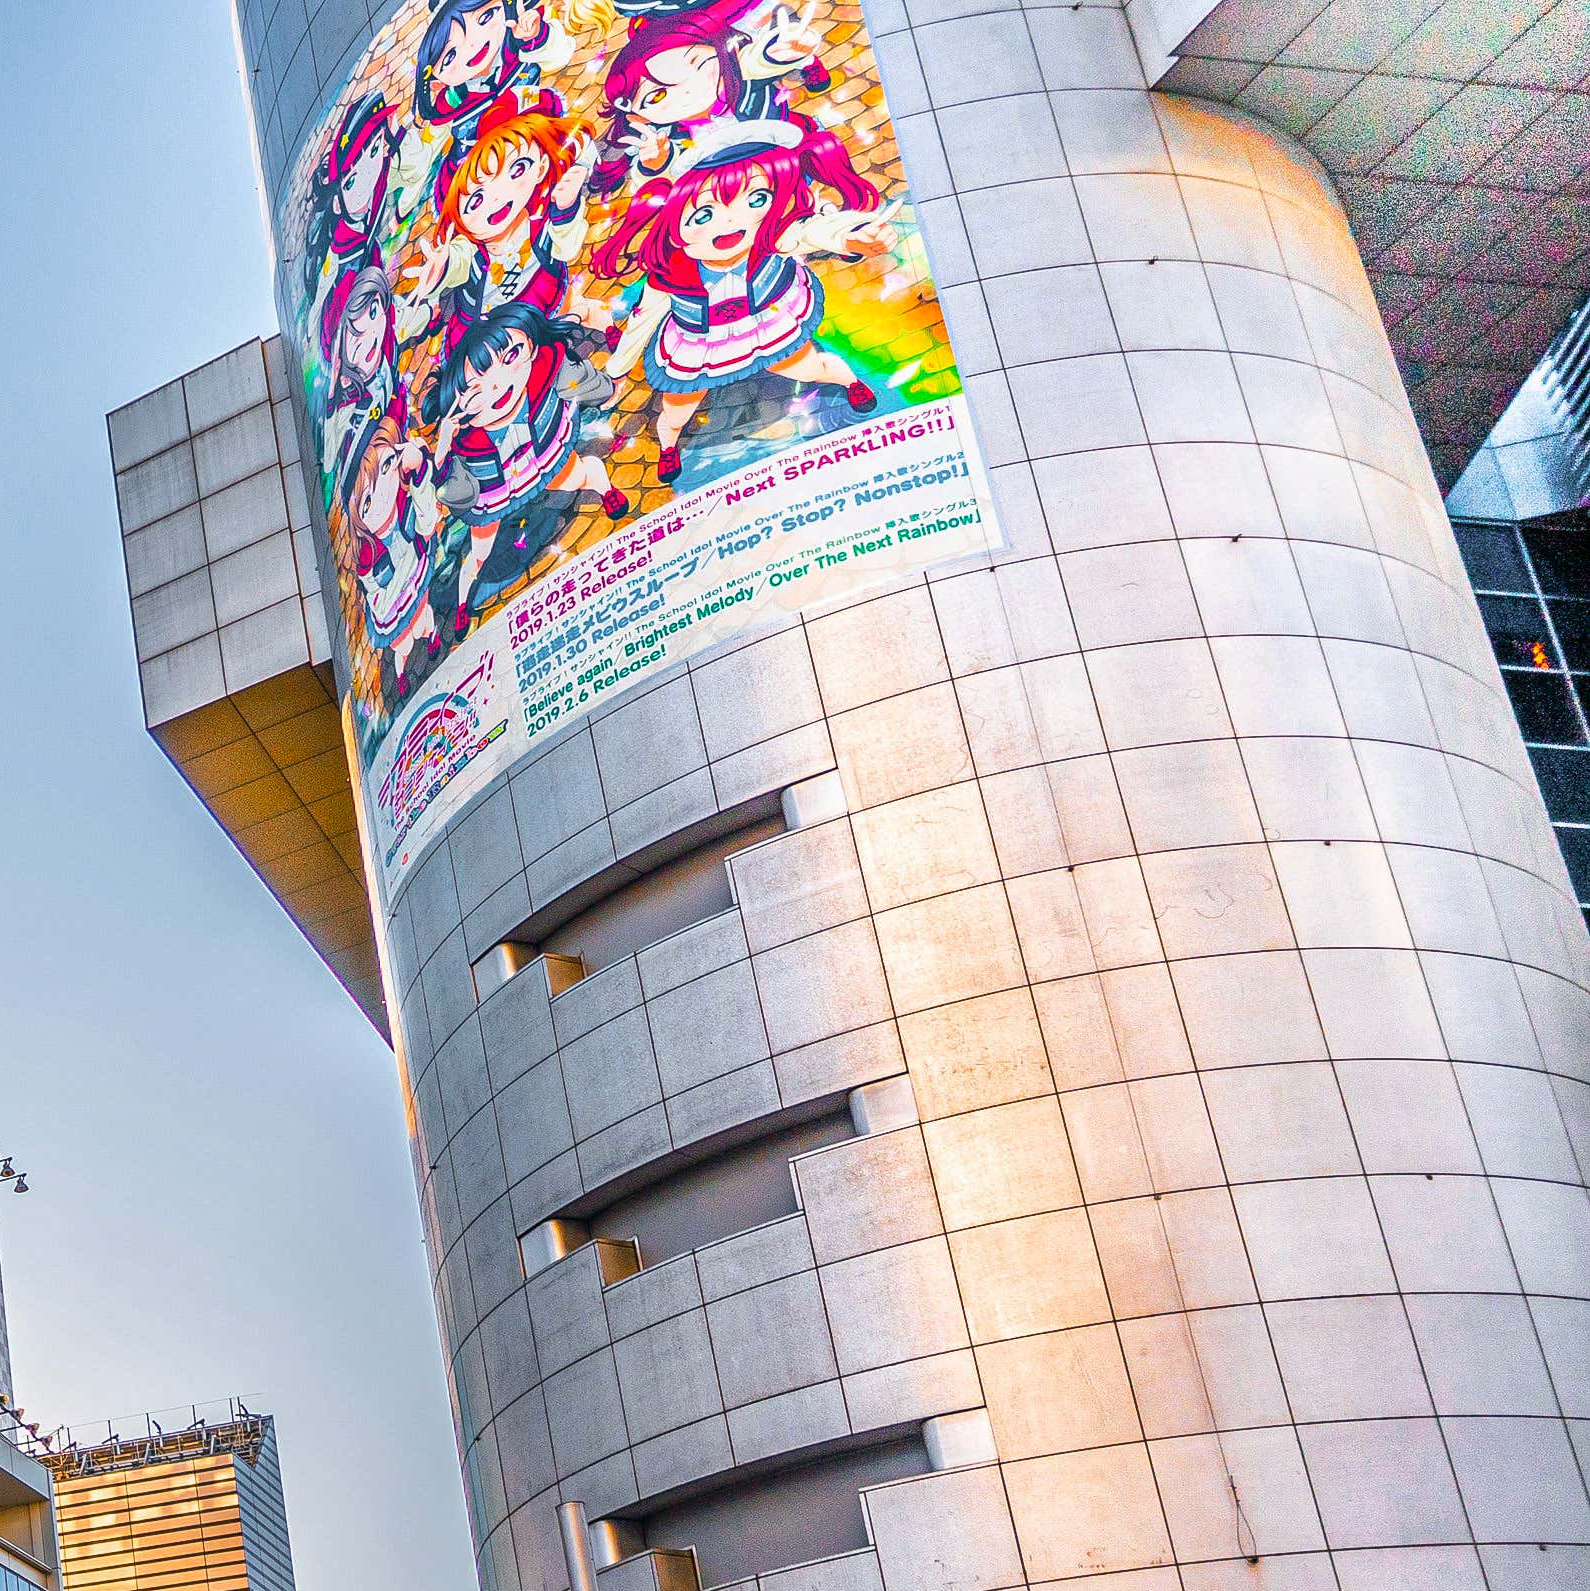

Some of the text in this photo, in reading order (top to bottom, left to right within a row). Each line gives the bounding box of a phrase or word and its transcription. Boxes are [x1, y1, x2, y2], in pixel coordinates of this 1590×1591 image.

[617, 433, 857, 545] The School Idol Movie Over The Rainbow
[625, 479, 869, 588] The School Idol Movie Over The Rainbow
[781, 498, 847, 533] Stop?
[510, 550, 653, 650] 2019.1.23 Release!
[635, 525, 881, 634] The School Idol Movie Over The Rainbow
[815, 549, 848, 571] The
[852, 534, 894, 557] Next
[518, 593, 666, 694] 2019.1.30 Release!
[527, 644, 667, 738] 2019.2.6 Release!
